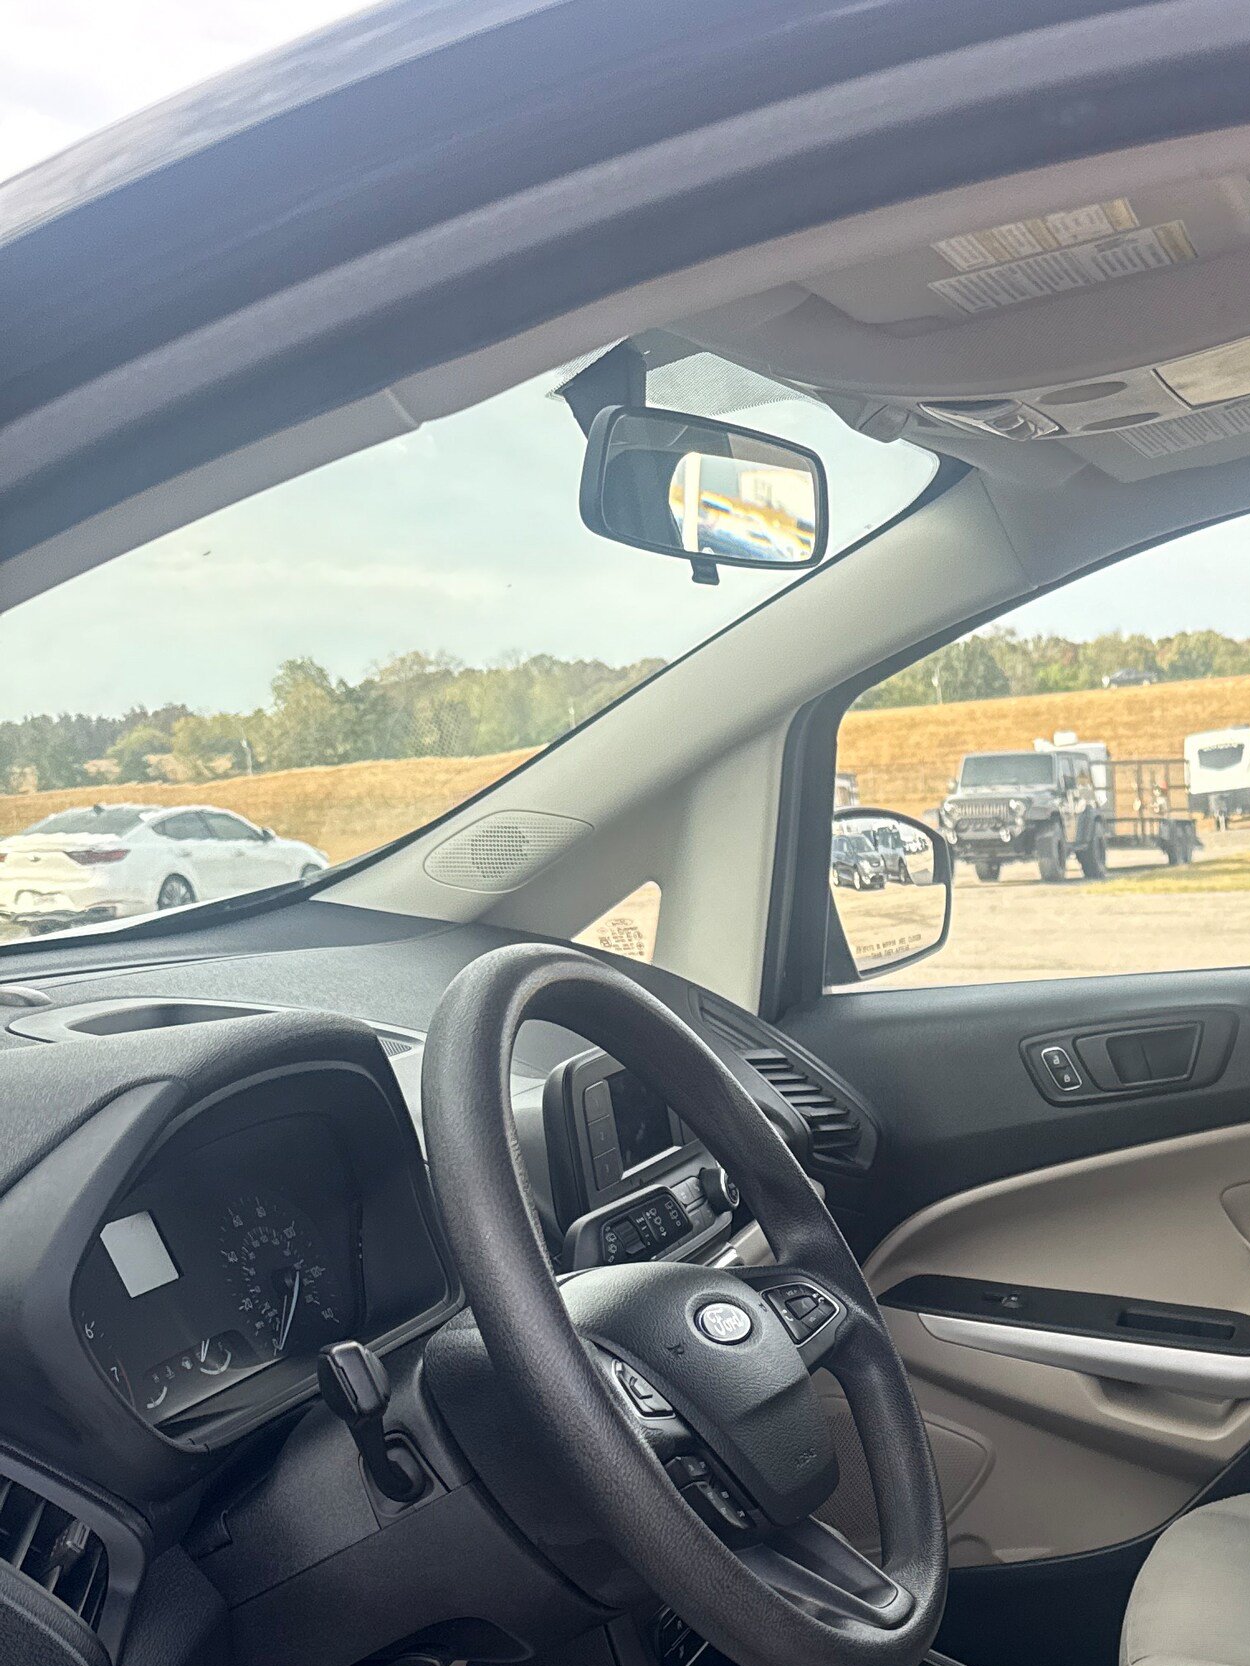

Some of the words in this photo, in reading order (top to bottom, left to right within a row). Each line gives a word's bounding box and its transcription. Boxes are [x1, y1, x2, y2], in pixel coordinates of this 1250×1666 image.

[707, 1308, 744, 1335] Ford
[85, 1322, 94, 1339] 6
[110, 1366, 120, 1383] 7
